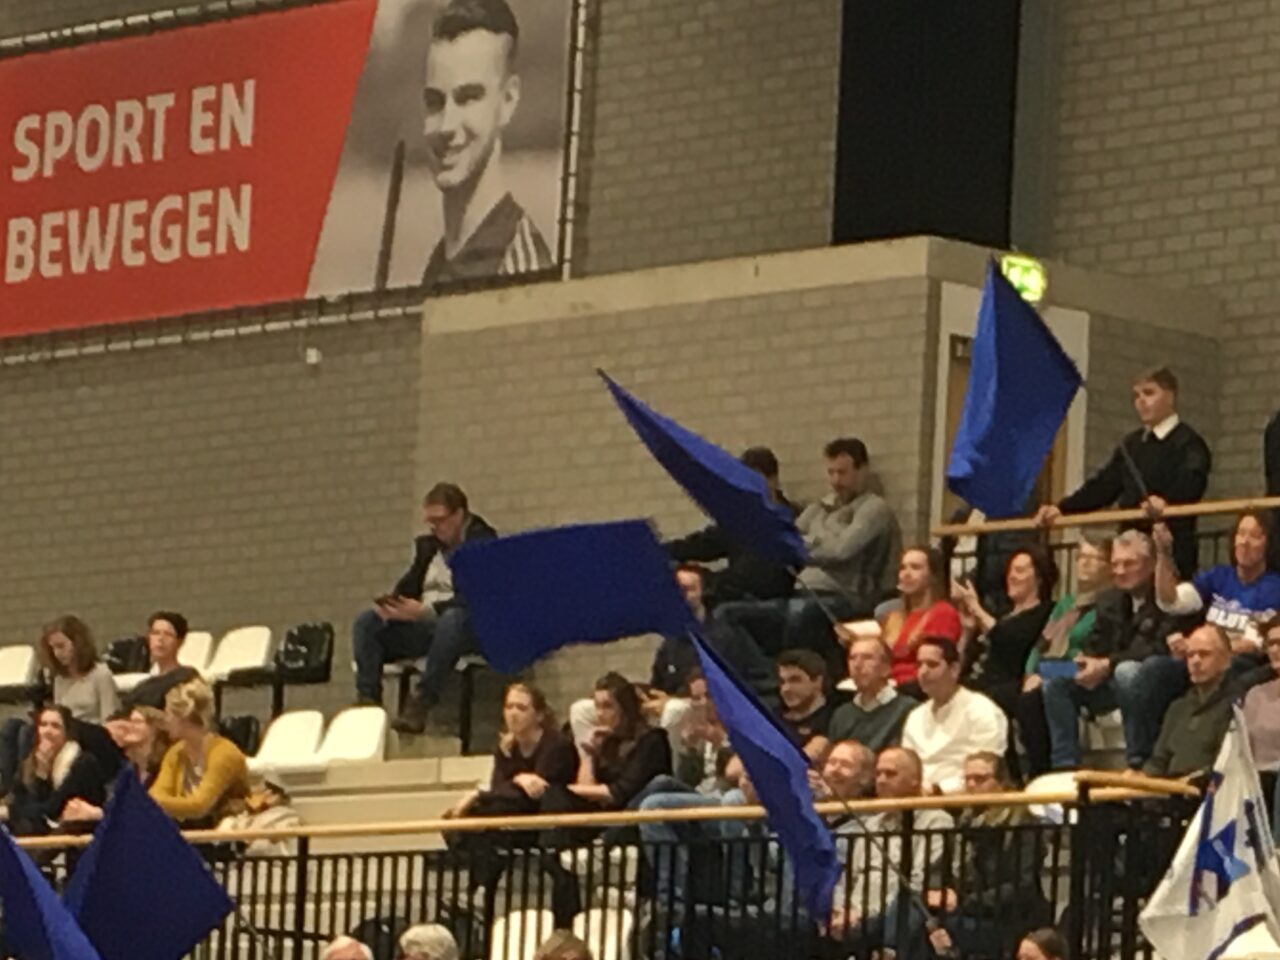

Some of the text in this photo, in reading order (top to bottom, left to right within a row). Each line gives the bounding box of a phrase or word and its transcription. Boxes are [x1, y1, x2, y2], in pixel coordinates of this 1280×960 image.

[12, 79, 256, 182] SPORT EN
[5, 184, 252, 283] BEWEGEN
